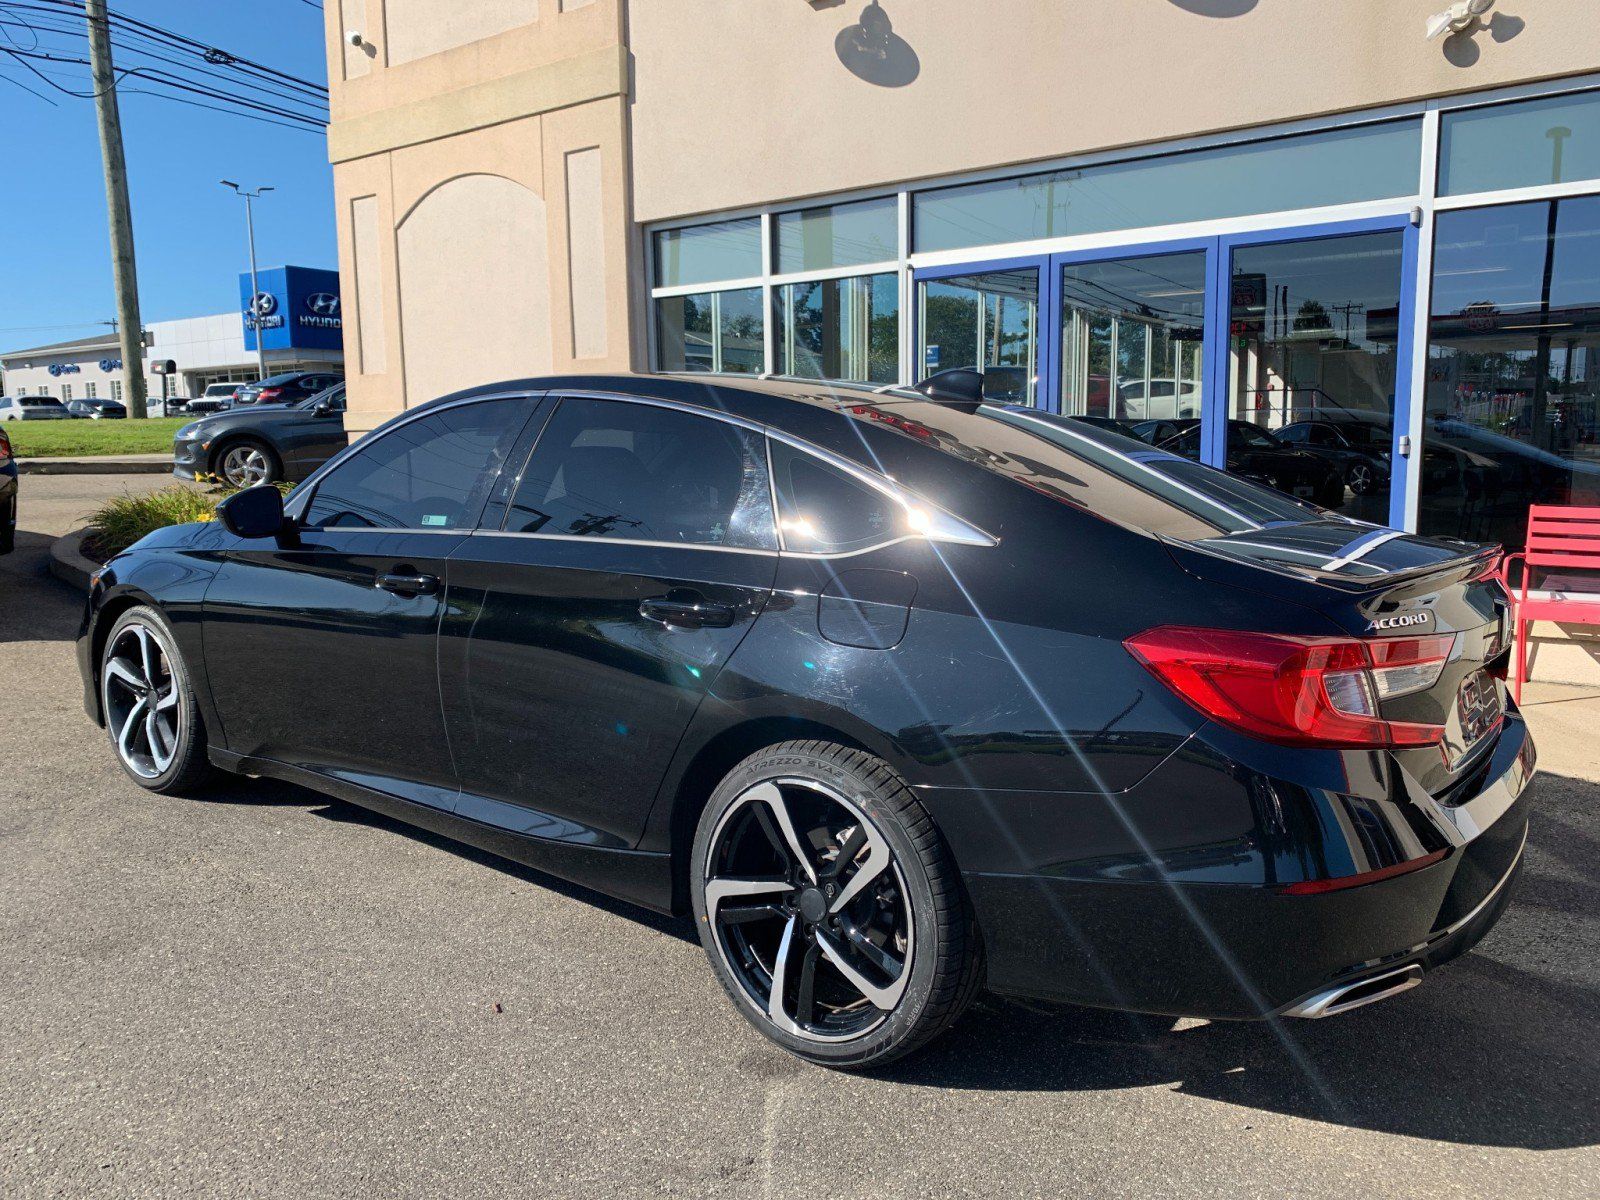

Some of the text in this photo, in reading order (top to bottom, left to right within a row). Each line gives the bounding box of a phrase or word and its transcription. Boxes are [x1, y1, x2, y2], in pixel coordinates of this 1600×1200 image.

[245, 315, 281, 329] HYNDAI
[299, 315, 342, 328] HYUND
[1364, 612, 1428, 632] ACCORD
[746, 757, 845, 779] ATREZZO SVA2
